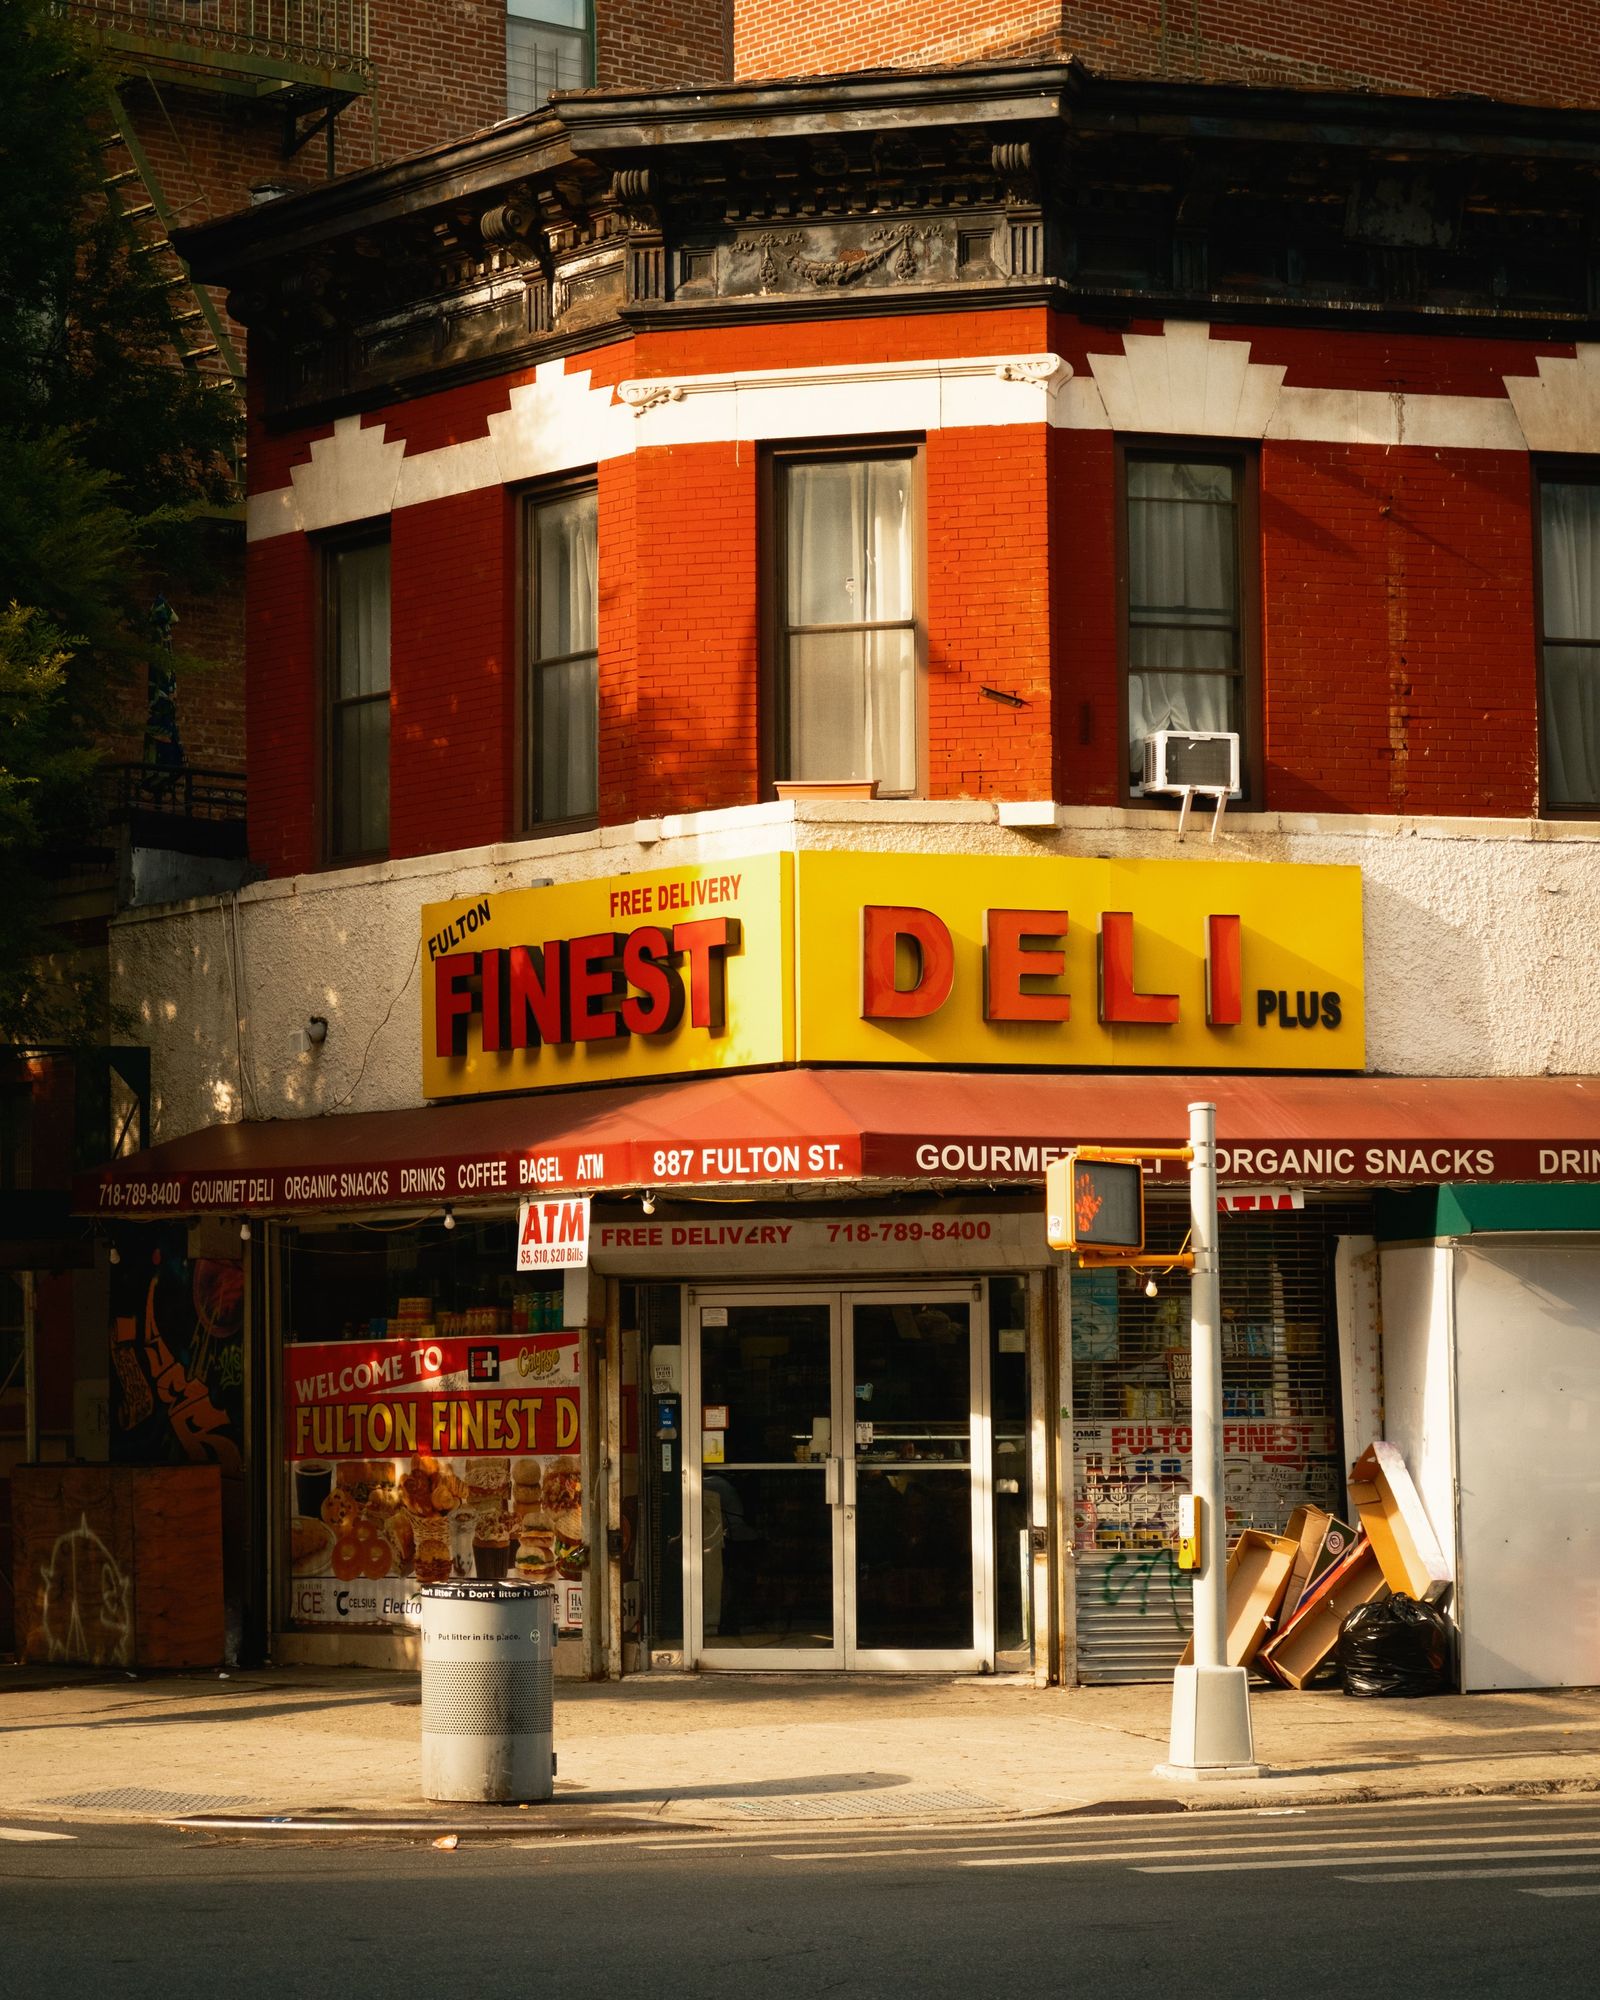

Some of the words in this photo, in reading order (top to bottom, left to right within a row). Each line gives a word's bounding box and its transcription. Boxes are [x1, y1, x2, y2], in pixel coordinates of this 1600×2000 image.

[610, 886, 652, 918] FREE
[657, 873, 741, 911] DELIVERY
[428, 900, 491, 961] FULTON
[860, 904, 1242, 1025] DELI
[435, 916, 741, 1058] FINEST
[1257, 989, 1342, 1029] PLUS
[653, 1149, 695, 1176] 887
[702, 1145, 800, 1175] FULTON
[807, 1144, 844, 1172] ST.
[1214, 1148, 1355, 1174] ORGANIC
[1365, 1148, 1495, 1174] SNACKS
[99, 1181, 181, 1206] 718-789-8400
[191, 1178, 247, 1204] GOURMET
[249, 1178, 274, 1202] DELI
[284, 1174, 338, 1201] ORGANIC
[340, 1170, 389, 1197] SNACKS
[400, 1166, 446, 1193] DRINKS
[457, 1161, 507, 1189] COFFEE
[519, 1156, 564, 1184] BAGEL
[576, 1153, 604, 1180] ATM
[521, 1202, 584, 1245] ATM
[601, 1228, 663, 1247] FREE
[671, 1225, 793, 1246] DELIVERY
[826, 1221, 991, 1243] 718-789-8400
[521, 1249, 533, 1265] $5,
[534, 1248, 550, 1264] $10,
[551, 1248, 565, 1263] $20
[567, 1248, 584, 1262] Bills
[294, 1355, 405, 1402] WELCOME
[411, 1346, 443, 1376] TO
[517, 1345, 560, 1378] Calypso
[296, 1402, 418, 1454] FULTON
[432, 1397, 543, 1451] FINEST
[1073, 1430, 1101, 1440] OME
[1111, 1426, 1192, 1454] FULTO
[1223, 1424, 1314, 1452] FINEST
[297, 1591, 322, 1614] ICE
[349, 1598, 377, 1609] CELSIUS
[434, 1588, 453, 1598] litter
[469, 1589, 496, 1598] Don't
[499, 1589, 521, 1598] litter
[438, 1633, 450, 1641] Put
[451, 1633, 472, 1641] litter
[473, 1633, 481, 1641] in
[483, 1633, 494, 1641] its
[496, 1633, 521, 1642] place.
